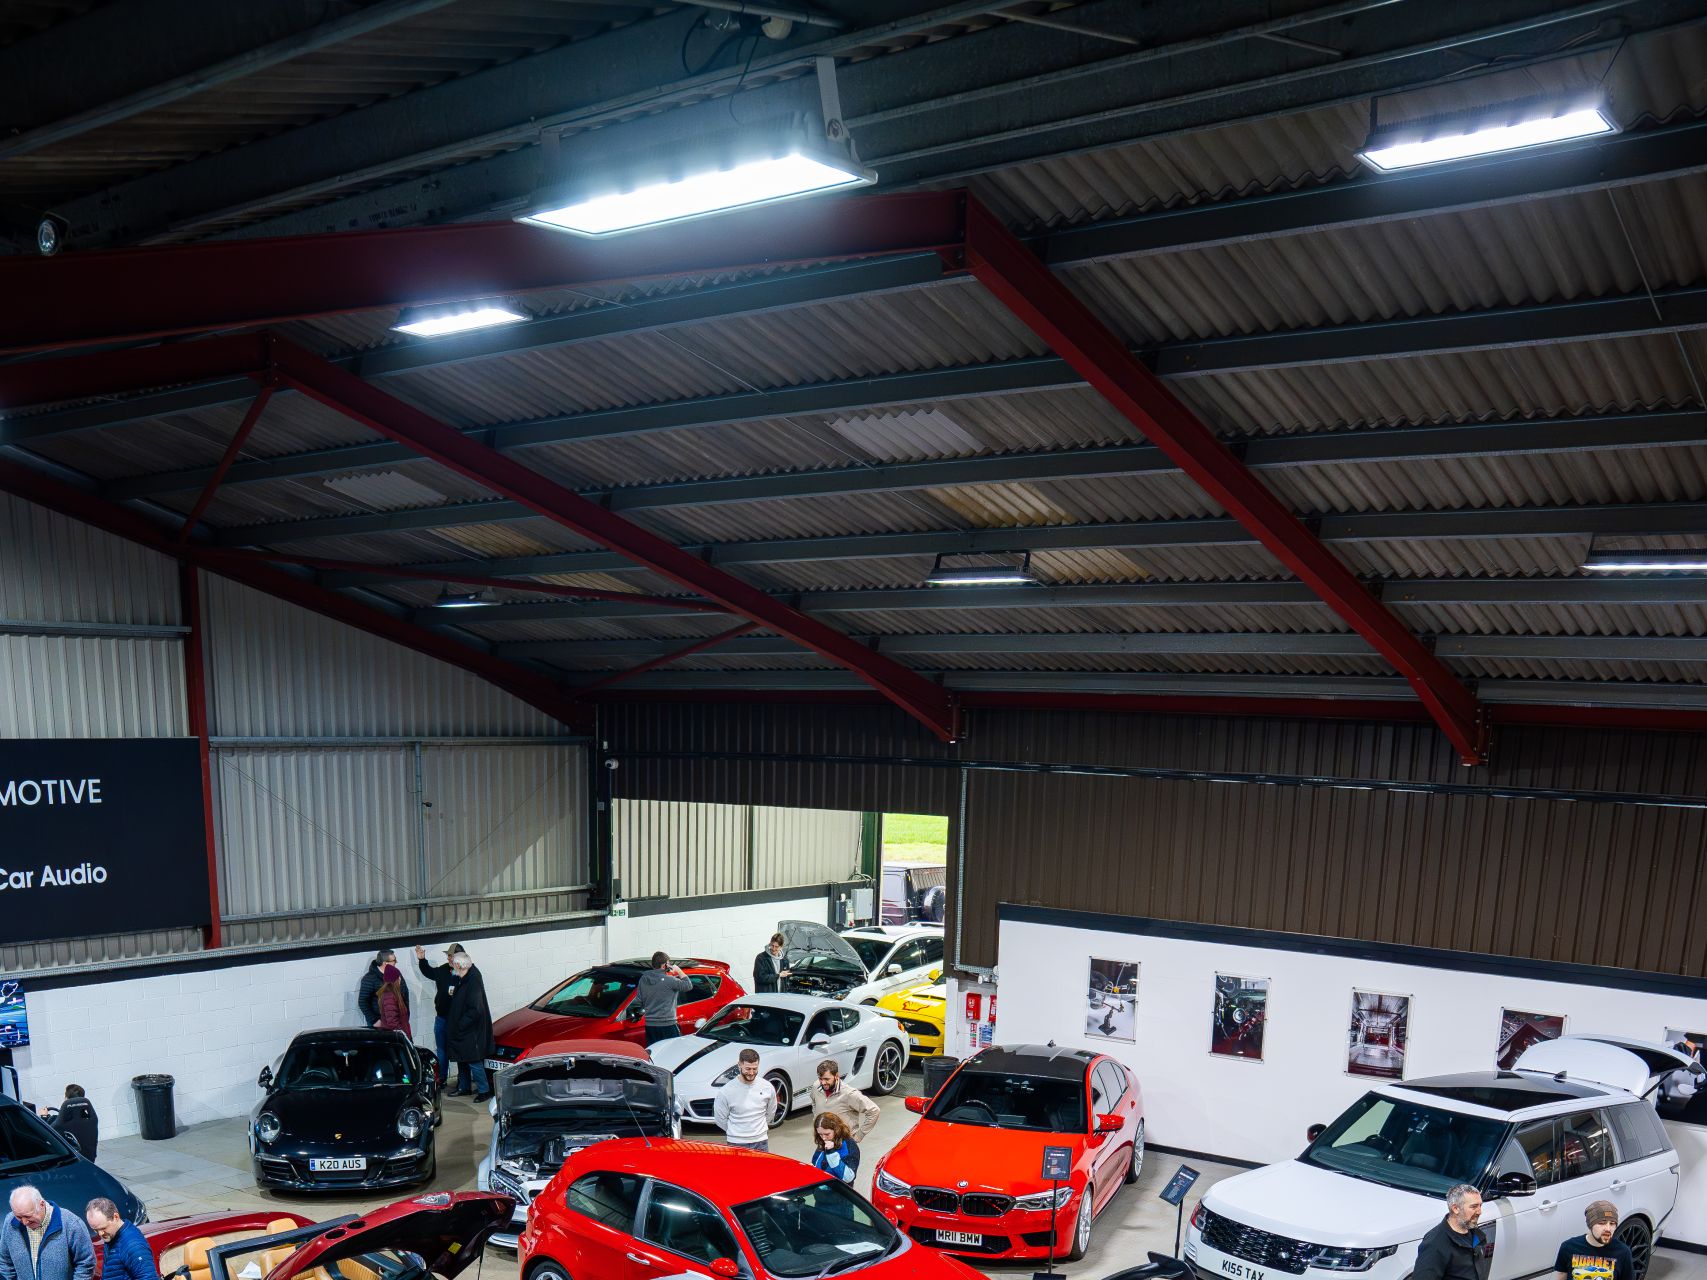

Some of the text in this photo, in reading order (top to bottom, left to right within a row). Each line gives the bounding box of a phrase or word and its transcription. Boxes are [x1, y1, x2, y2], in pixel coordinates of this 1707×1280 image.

[40, 862, 108, 887] Audio
[319, 1159, 362, 1170] K20 AUS
[959, 1232, 981, 1244] BMW
